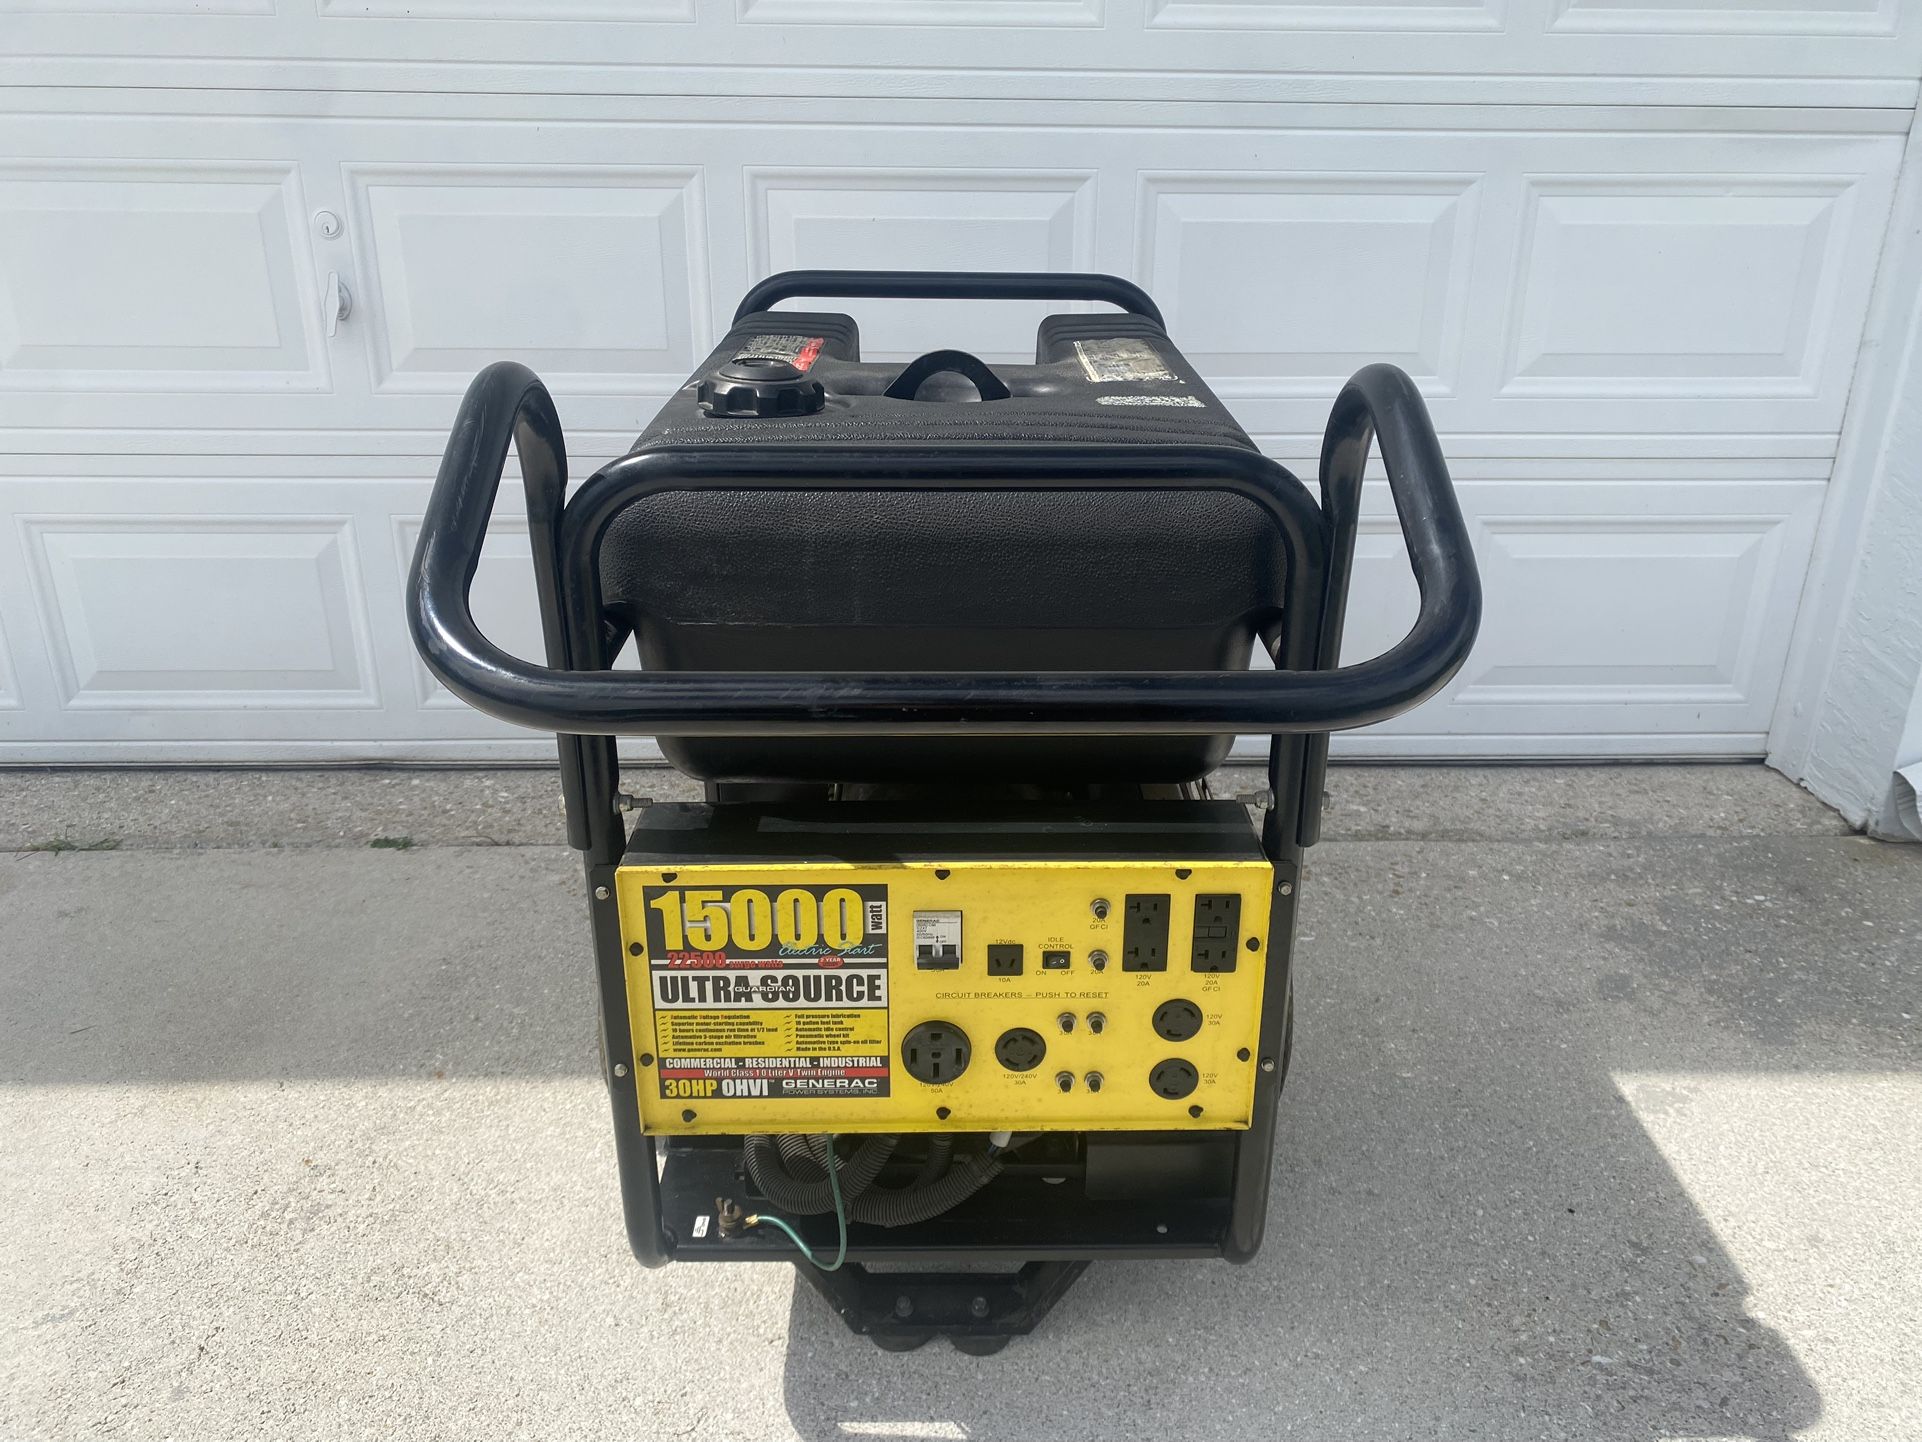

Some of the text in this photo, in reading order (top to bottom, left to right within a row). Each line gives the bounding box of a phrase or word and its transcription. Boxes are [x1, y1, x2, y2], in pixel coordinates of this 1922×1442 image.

[650, 888, 864, 951] 15000
[869, 904, 882, 930] watt
[778, 941, 882, 956] Electric Start
[666, 951, 726, 968] 22500
[758, 960, 783, 968] watts
[659, 974, 882, 1003] ULTRA SOURCE
[666, 1058, 737, 1068] COMMERCIAL
[745, 1058, 811, 1068] RESIDENTIAL
[820, 1057, 882, 1067] INDUSTRIAL
[665, 1079, 768, 1097] 30HP OHVI
[782, 1079, 877, 1088] GENERAC
